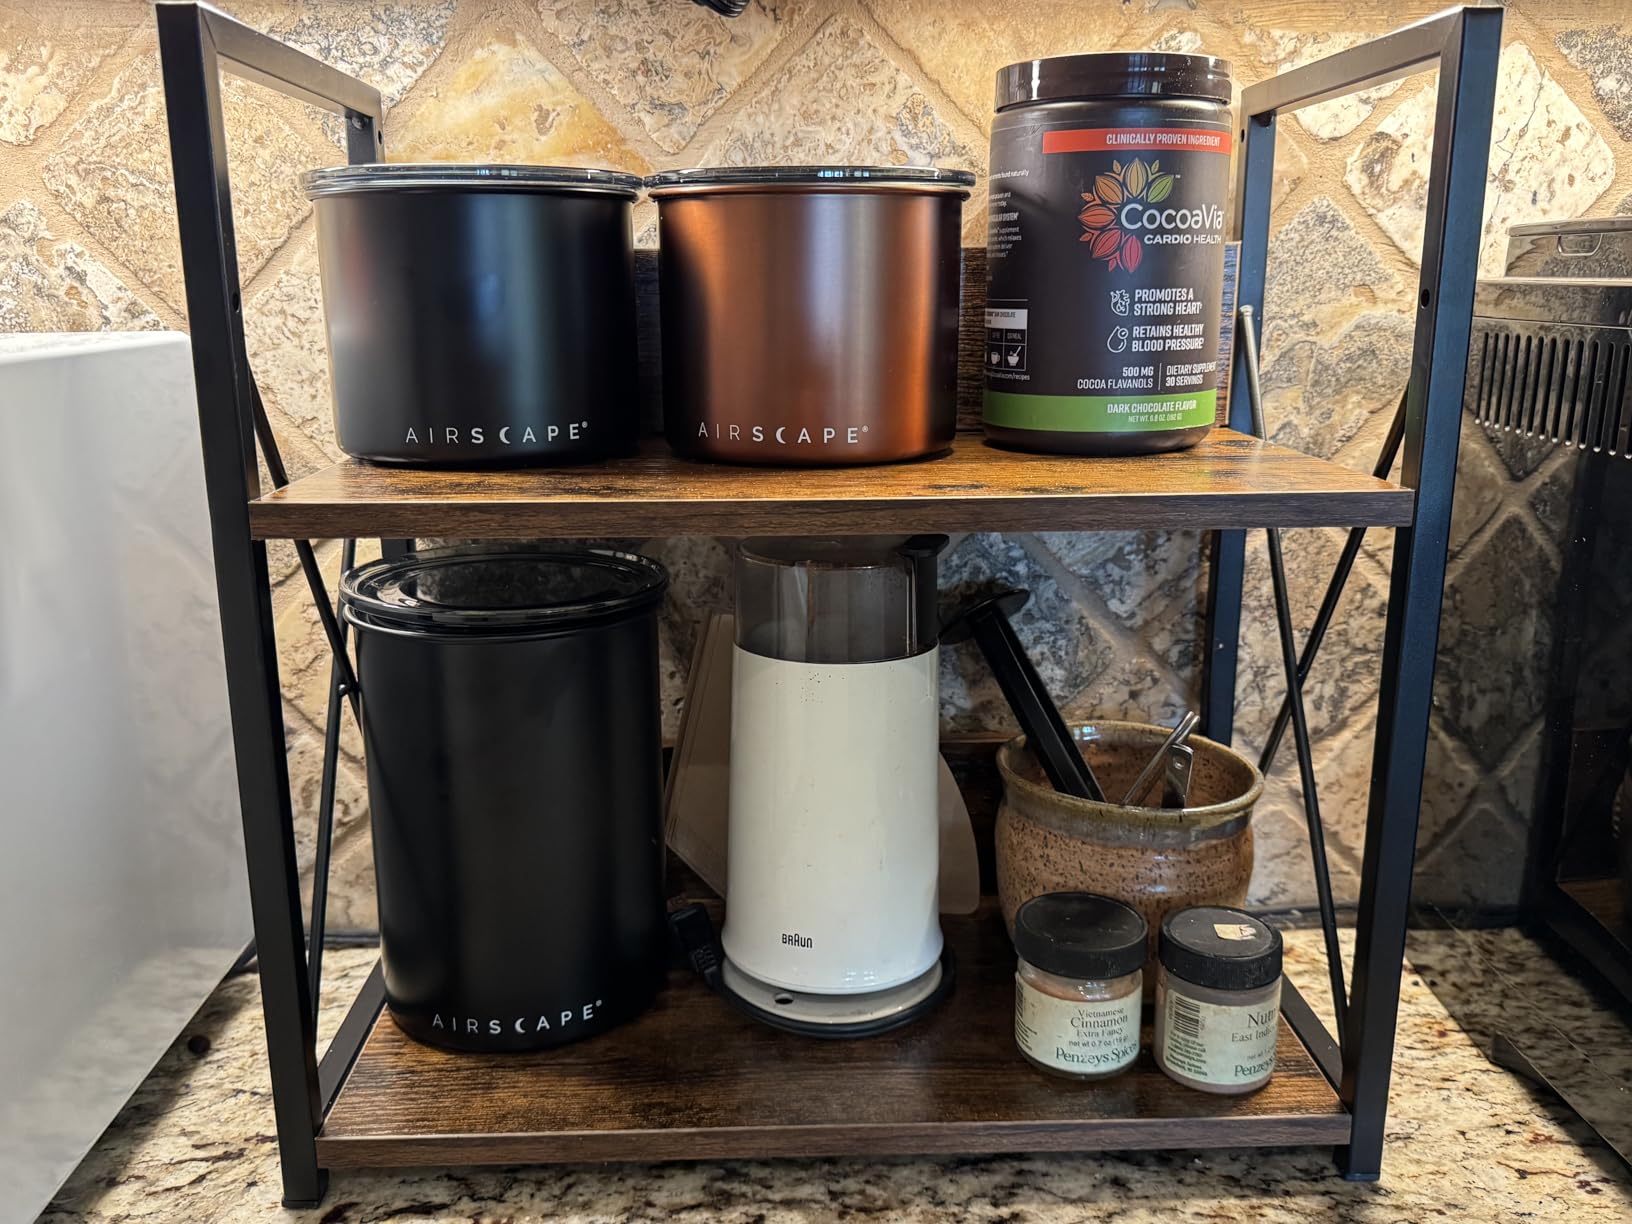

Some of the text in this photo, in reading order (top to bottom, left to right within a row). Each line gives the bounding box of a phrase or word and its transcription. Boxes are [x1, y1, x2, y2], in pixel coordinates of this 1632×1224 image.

[1106, 133, 1220, 147] CLINICALLY PROVEN INGREDIENT
[1120, 203, 1223, 230] CocoaVia
[1144, 234, 1222, 245] CARDIO HEALTH
[1134, 288, 1194, 301] PROMOTES A
[1133, 302, 1174, 316] STRONG
[1132, 324, 1204, 338] RETAINS HEALTHY
[1132, 339, 1164, 352] BLOOD
[1122, 366, 1154, 377] 500 MG
[1166, 364, 1192, 376] DIETARY
[1077, 378, 1154, 389] COCOA FLAVANOLS
[1165, 374, 1204, 387] 30 SERVINGS
[1107, 399, 1197, 414] DARK CHOCOLATE FLAVOR
[1078, 1007, 1125, 1018] Vietnamese
[1070, 1014, 1128, 1029] Cinnamon
[1076, 1027, 1123, 1038] Extra Fancy
[1231, 1032, 1253, 1042] East
[1056, 1046, 1111, 1067] Penzeys
